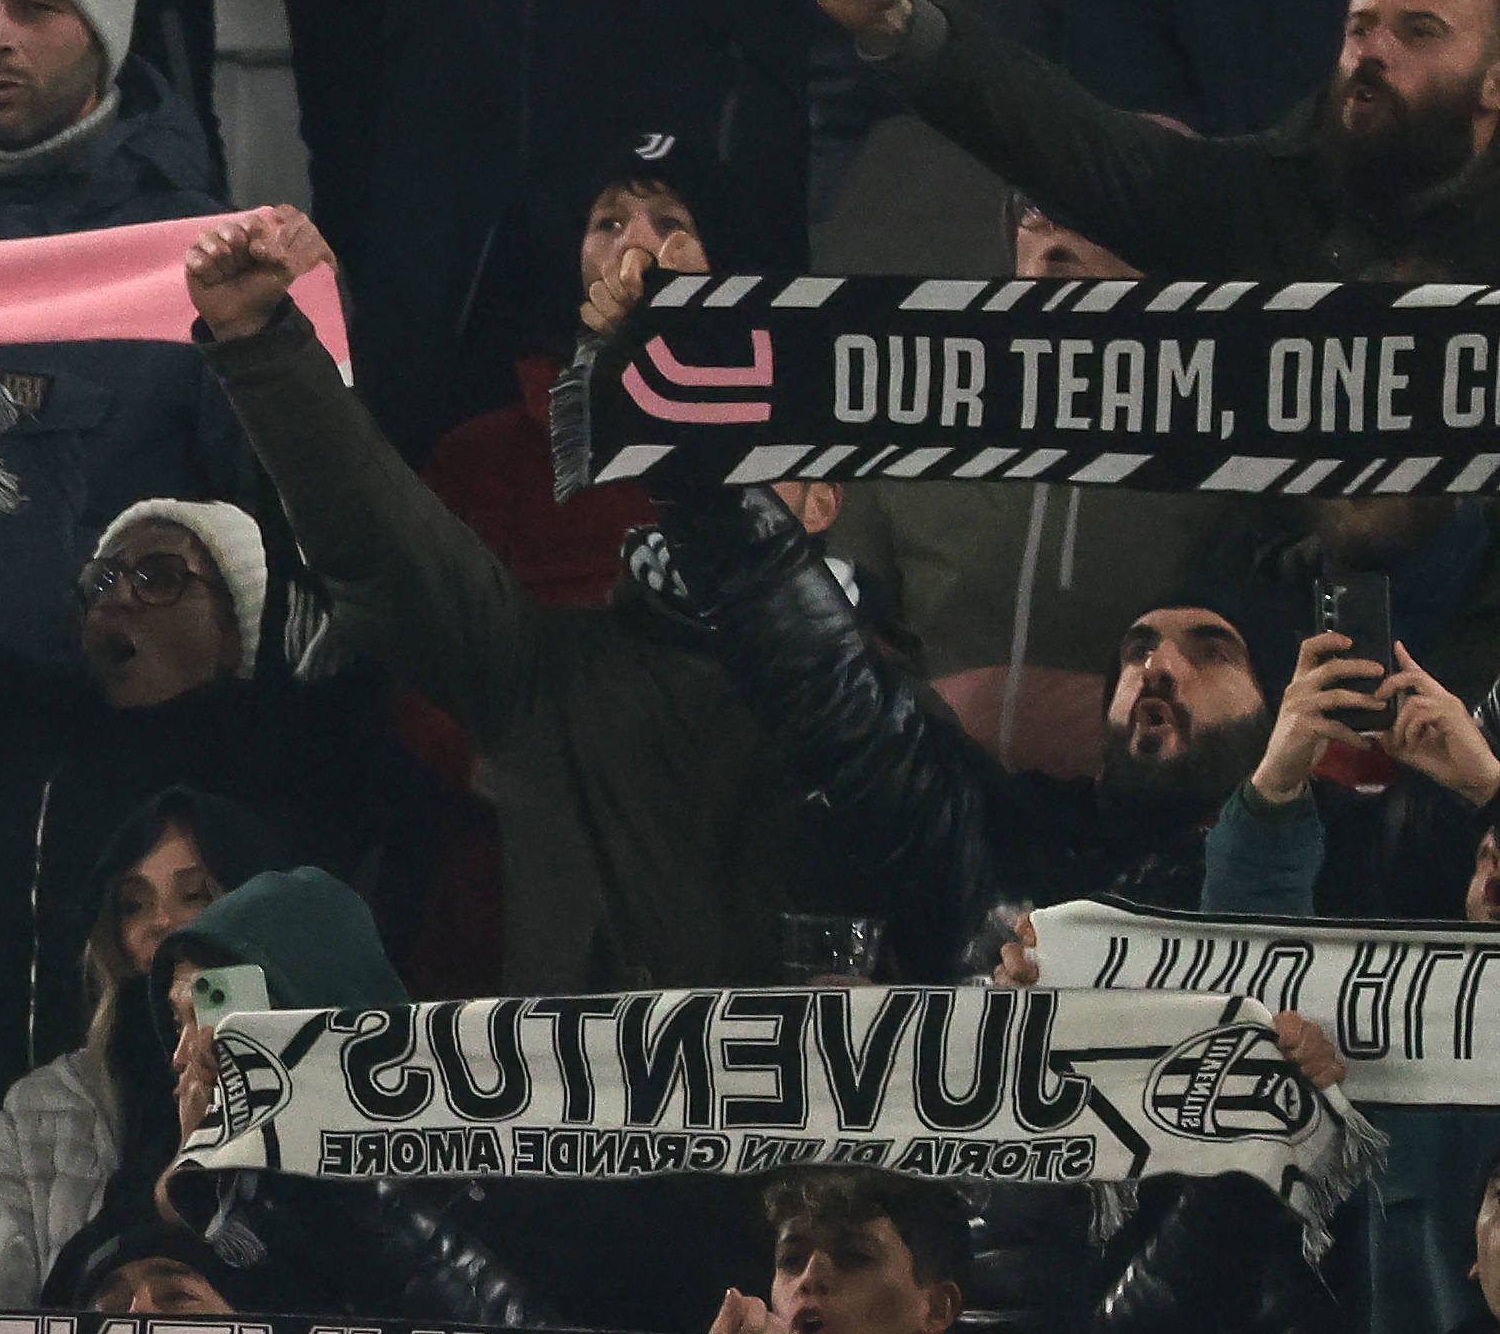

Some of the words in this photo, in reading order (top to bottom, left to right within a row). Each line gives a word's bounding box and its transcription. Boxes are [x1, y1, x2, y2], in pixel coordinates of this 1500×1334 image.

[833, 333, 987, 429] OUR
[1008, 336, 1236, 441] TEAM,
[1266, 335, 1416, 434] ONE
